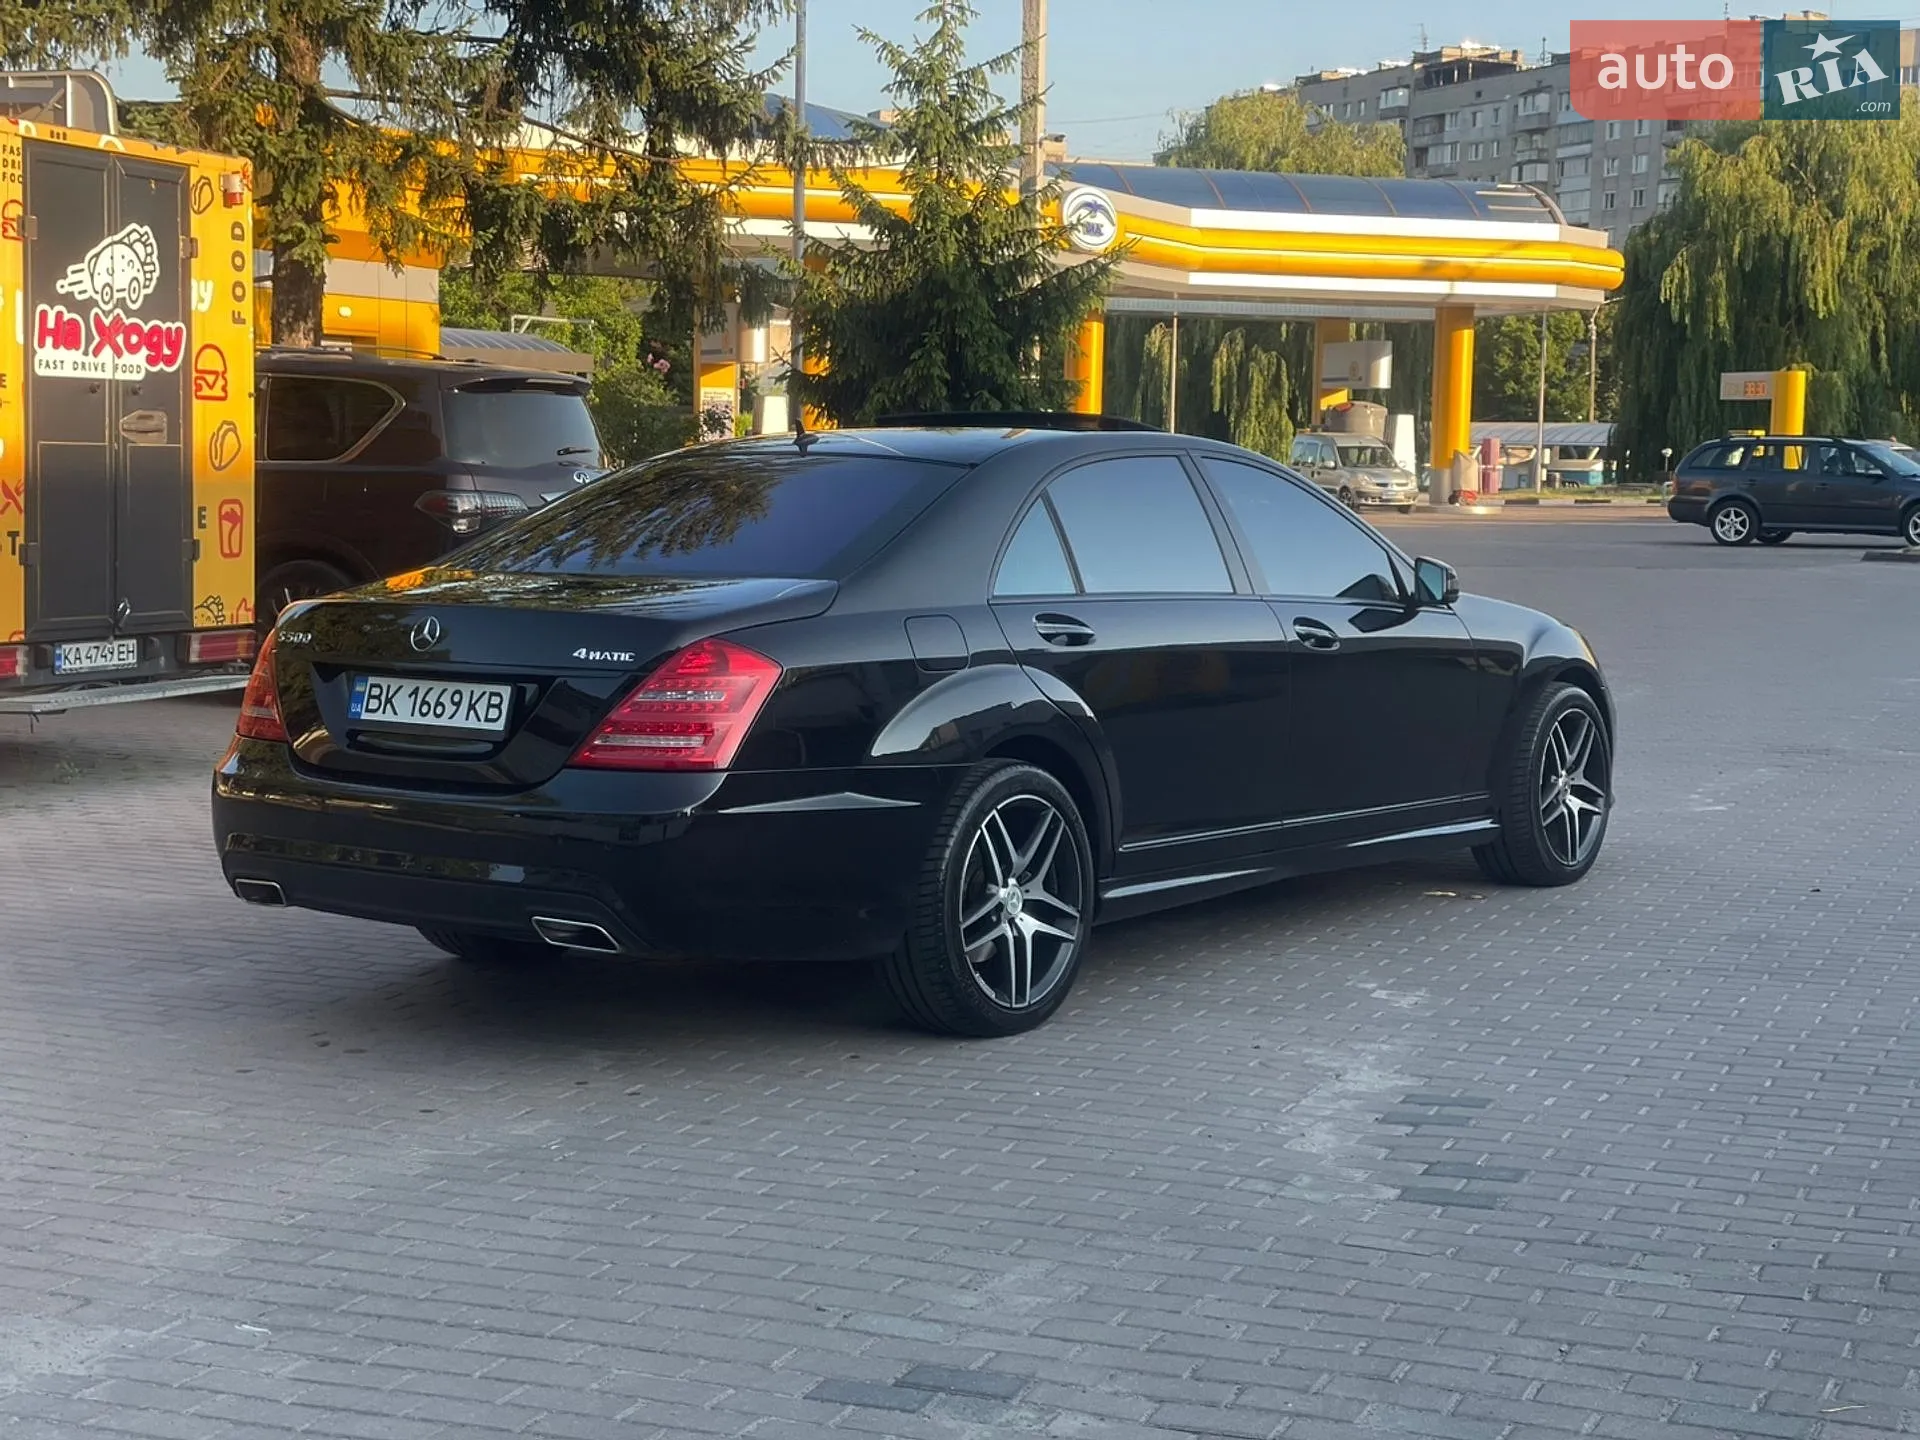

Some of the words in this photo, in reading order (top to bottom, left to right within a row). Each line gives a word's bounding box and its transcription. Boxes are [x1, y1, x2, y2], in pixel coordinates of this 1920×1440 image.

[230, 220, 246, 325] FOOD
[38, 359, 65, 371] FAST
[72, 361, 107, 373] DRIVE
[115, 364, 142, 375] FOOD
[62, 646, 83, 666] KA
[85, 644, 114, 664] 4749
[117, 642, 135, 662] EH
[572, 647, 636, 662] 4MATIC
[364, 682, 404, 716] BK
[408, 685, 464, 720] 1669
[465, 689, 504, 724] KB
